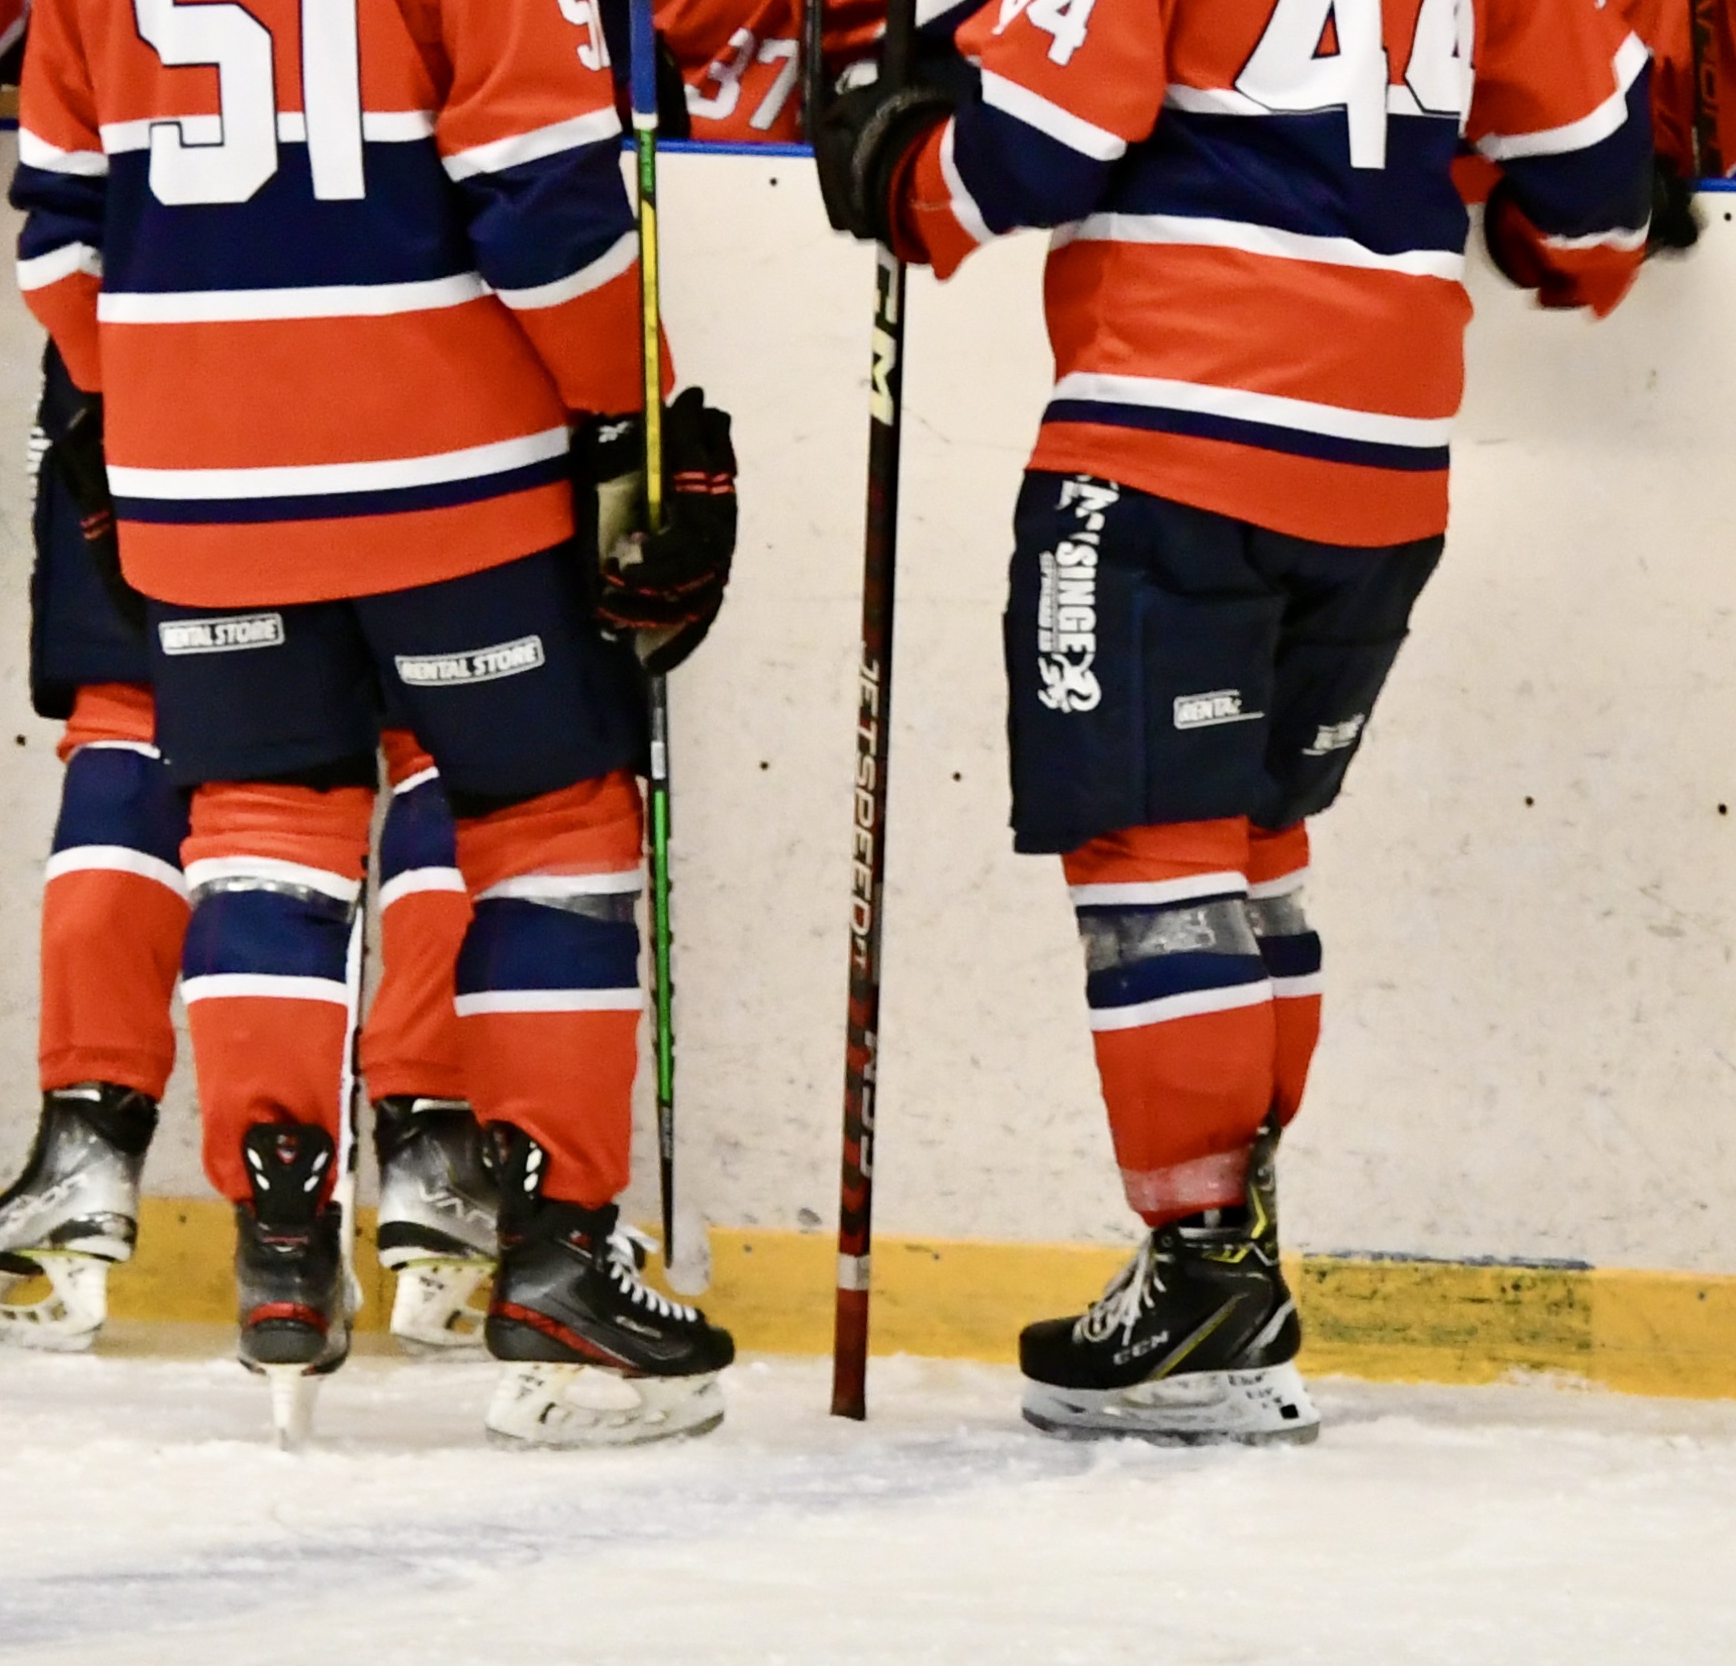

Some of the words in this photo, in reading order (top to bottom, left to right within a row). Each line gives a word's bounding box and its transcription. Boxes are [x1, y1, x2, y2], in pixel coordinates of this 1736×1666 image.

[683, 26, 801, 132] 37
[401, 658, 471, 681] RENTAL
[472, 644, 539, 677] STORE
[850, 656, 881, 935] JETSPEED
[1112, 1330, 1169, 1366] CCM
